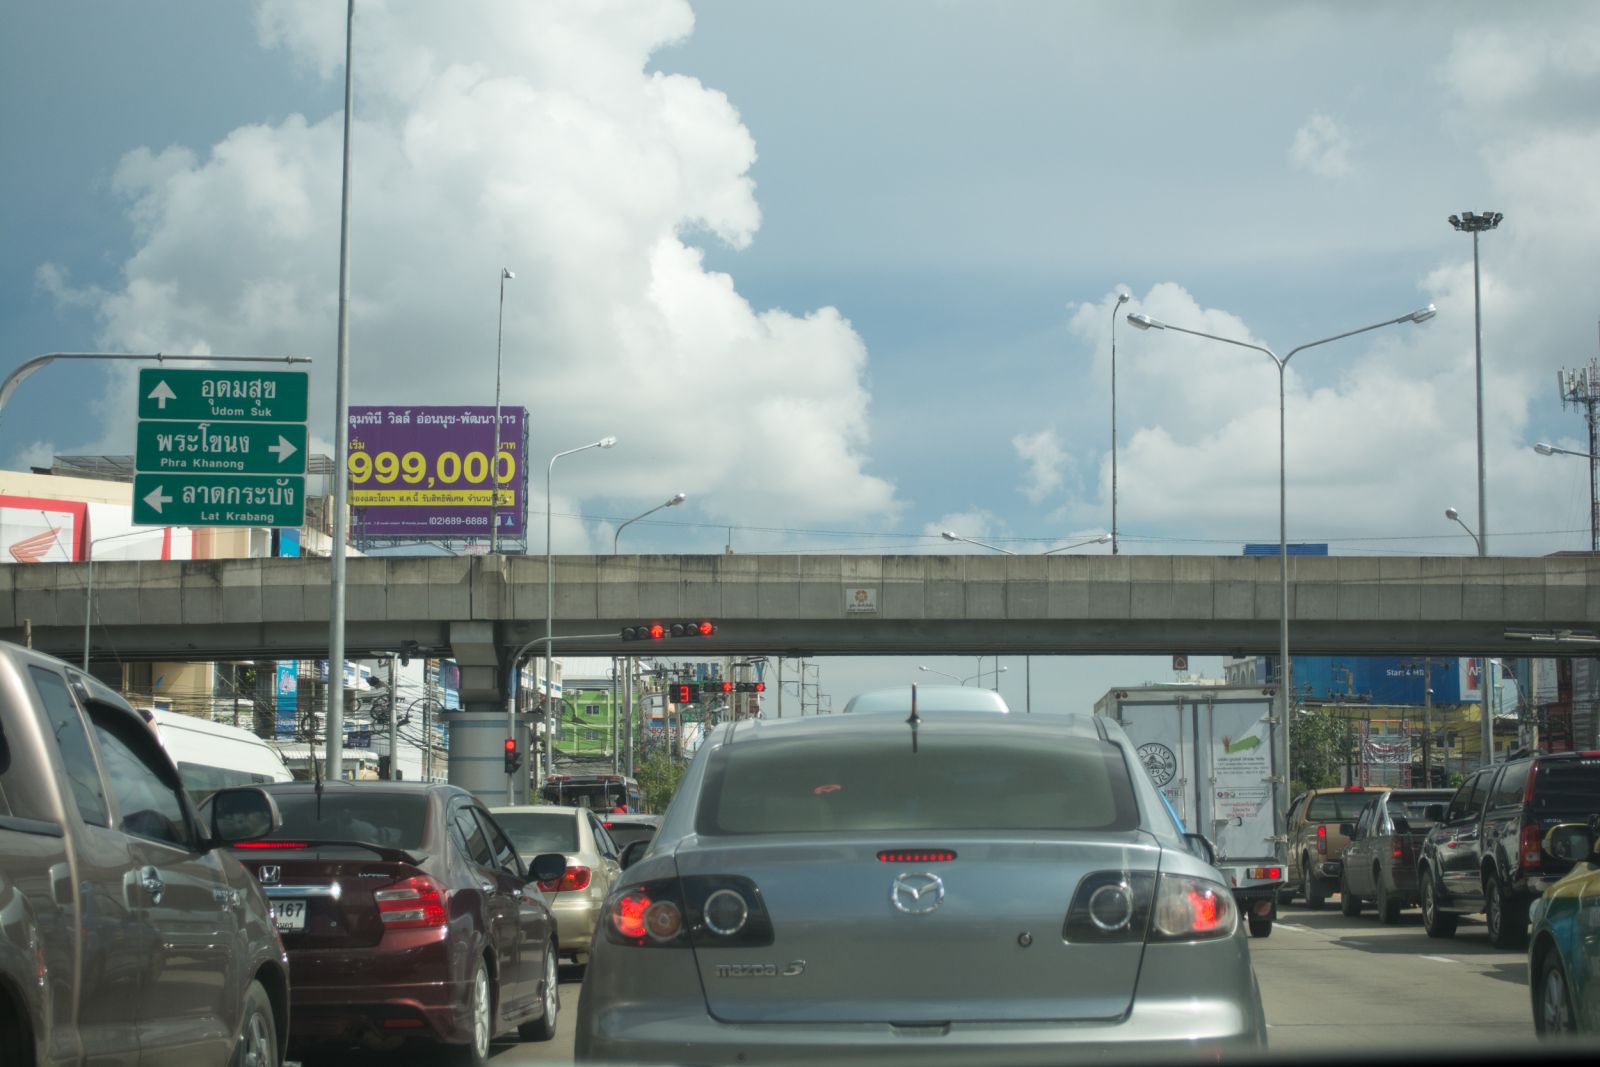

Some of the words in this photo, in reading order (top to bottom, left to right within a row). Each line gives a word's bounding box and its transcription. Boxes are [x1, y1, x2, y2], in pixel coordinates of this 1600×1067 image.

[201, 379, 276, 406] อุดมสุข
[211, 407, 244, 416] Udom
[251, 407, 272, 417] Suk
[156, 423, 250, 453] พระโขนง
[160, 459, 187, 467] Phra
[193, 459, 244, 470] Khanong
[348, 451, 516, 488] 999,000
[182, 479, 294, 505] ลาดกระบัง
[201, 512, 219, 520] Lat
[226, 512, 274, 523] Krabang
[680, 685, 689, 703] 3
